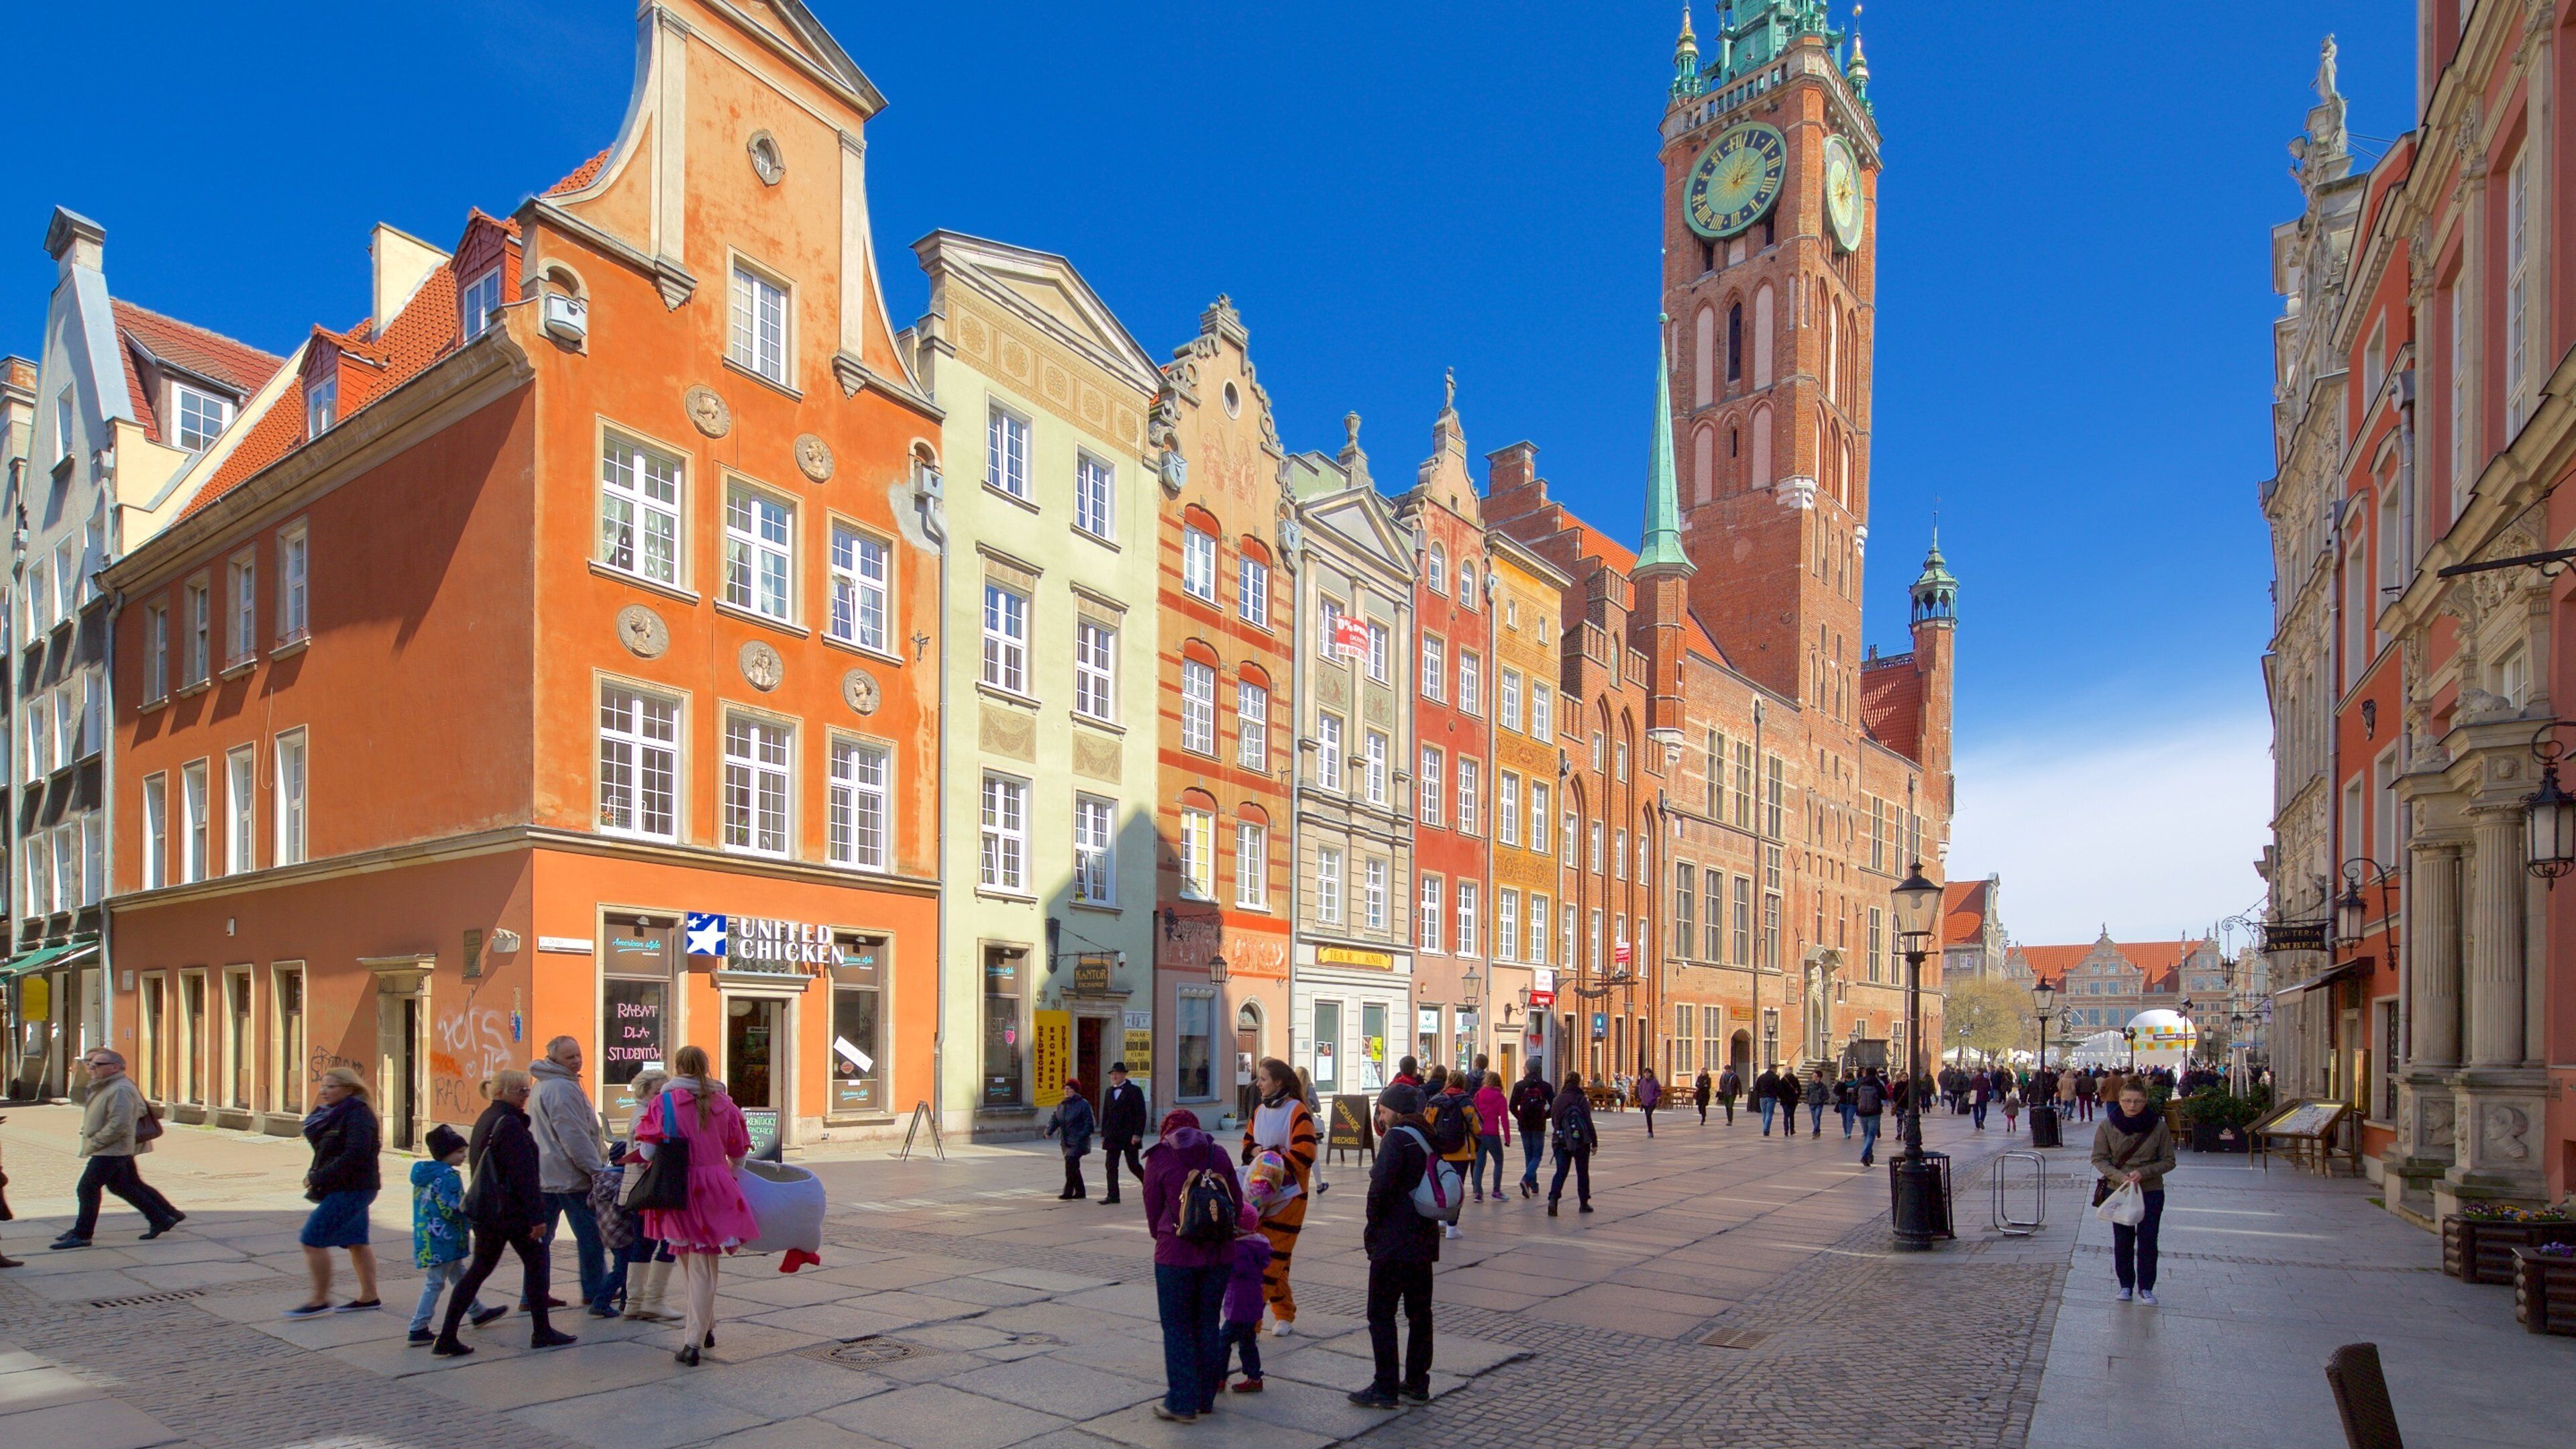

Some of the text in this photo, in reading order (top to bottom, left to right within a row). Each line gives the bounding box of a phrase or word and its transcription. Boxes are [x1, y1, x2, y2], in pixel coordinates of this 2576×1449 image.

[739, 917, 833, 944] UNITED
[612, 937, 661, 951] American style
[2269, 941, 2320, 950] AMBER
[739, 939, 845, 965] CHICKEN
[1329, 949, 1344, 961] TEA
[1075, 969, 1106, 980] KANTOR
[617, 1003, 658, 1018] RABAT
[623, 1026, 650, 1038] DLA
[608, 1043, 662, 1061] STUDENTÓW
[1335, 1100, 1361, 1132] EXCHANGE
[1332, 1136, 1359, 1144] WECHSEL
